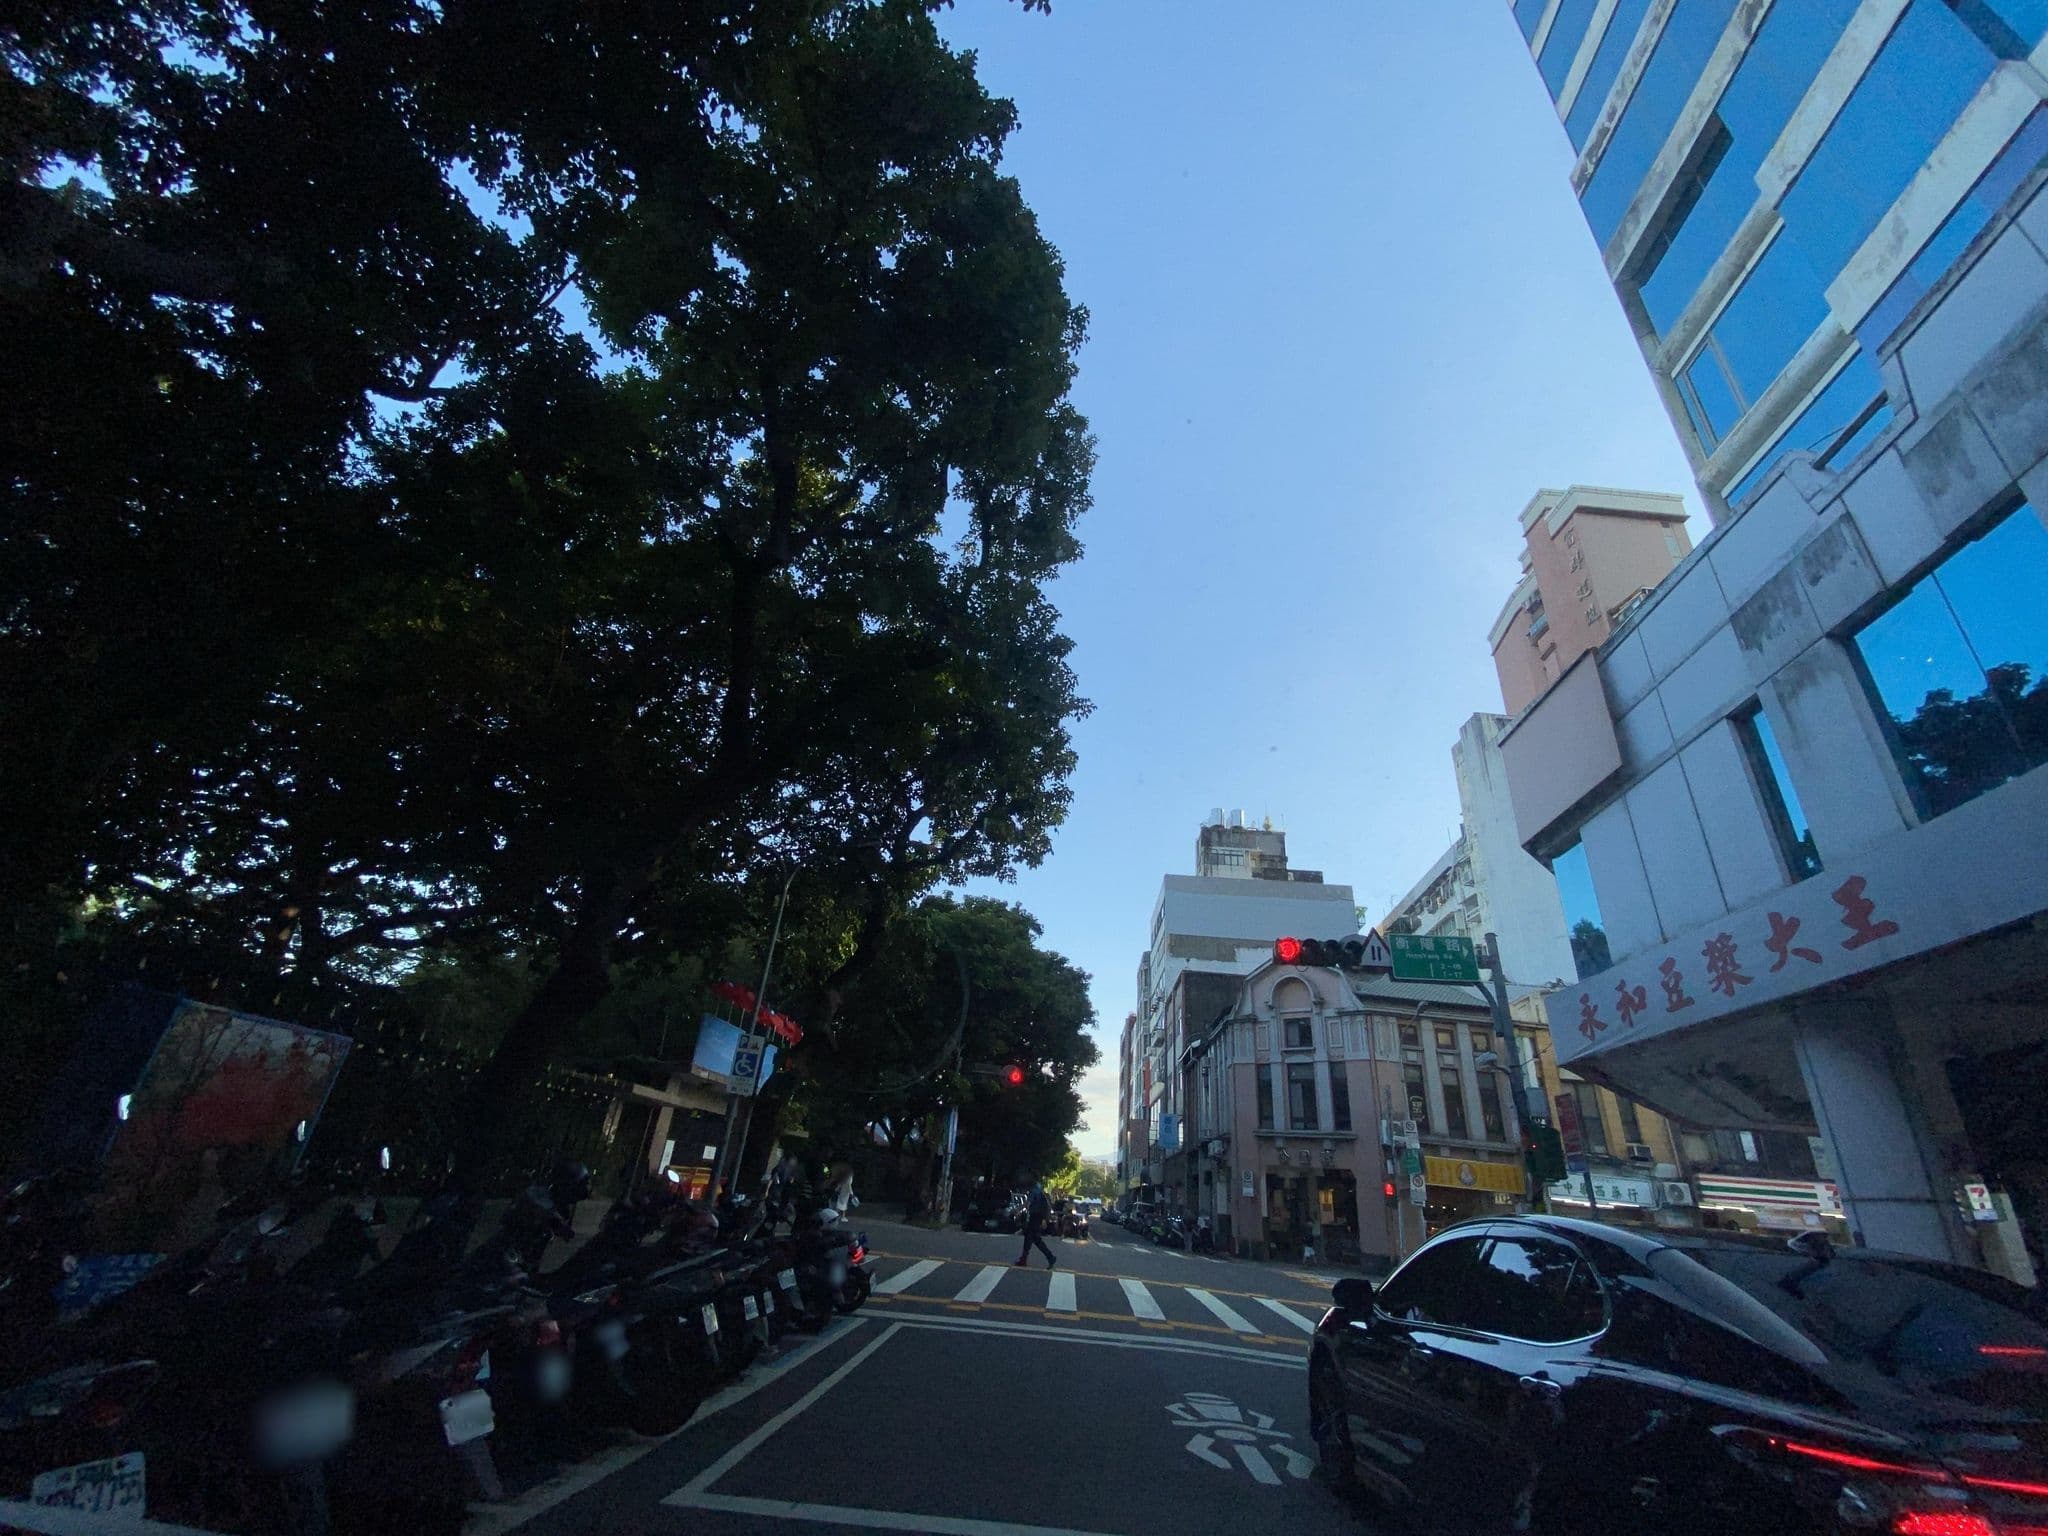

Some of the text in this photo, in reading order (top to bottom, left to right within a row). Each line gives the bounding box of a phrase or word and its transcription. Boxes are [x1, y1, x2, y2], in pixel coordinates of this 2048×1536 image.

[1578, 875, 1899, 1041] 永和豆漿大王
